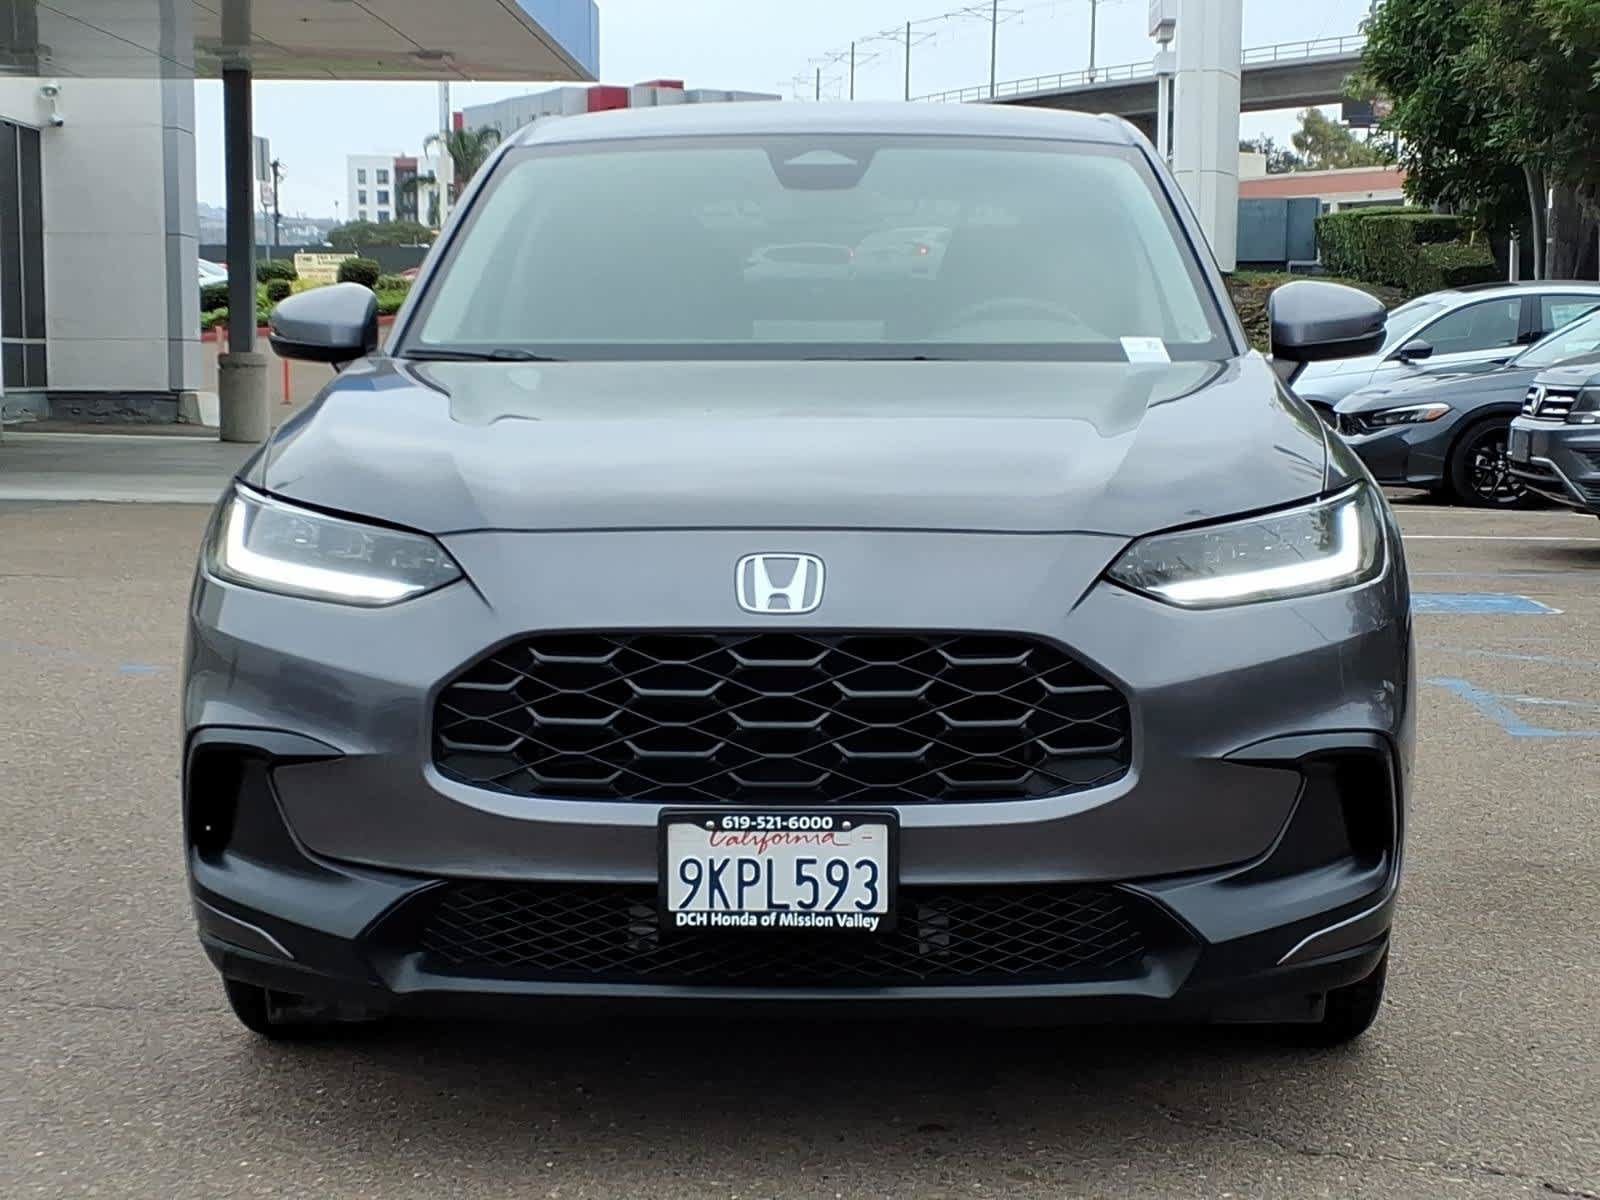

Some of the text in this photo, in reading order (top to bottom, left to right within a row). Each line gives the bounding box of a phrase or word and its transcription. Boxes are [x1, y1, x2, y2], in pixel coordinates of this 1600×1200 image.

[721, 815, 833, 830] 619-521-6000
[709, 829, 849, 855] California
[678, 857, 879, 911] 9KPL593
[676, 912, 880, 932] DCH Honda of Mission Valley
